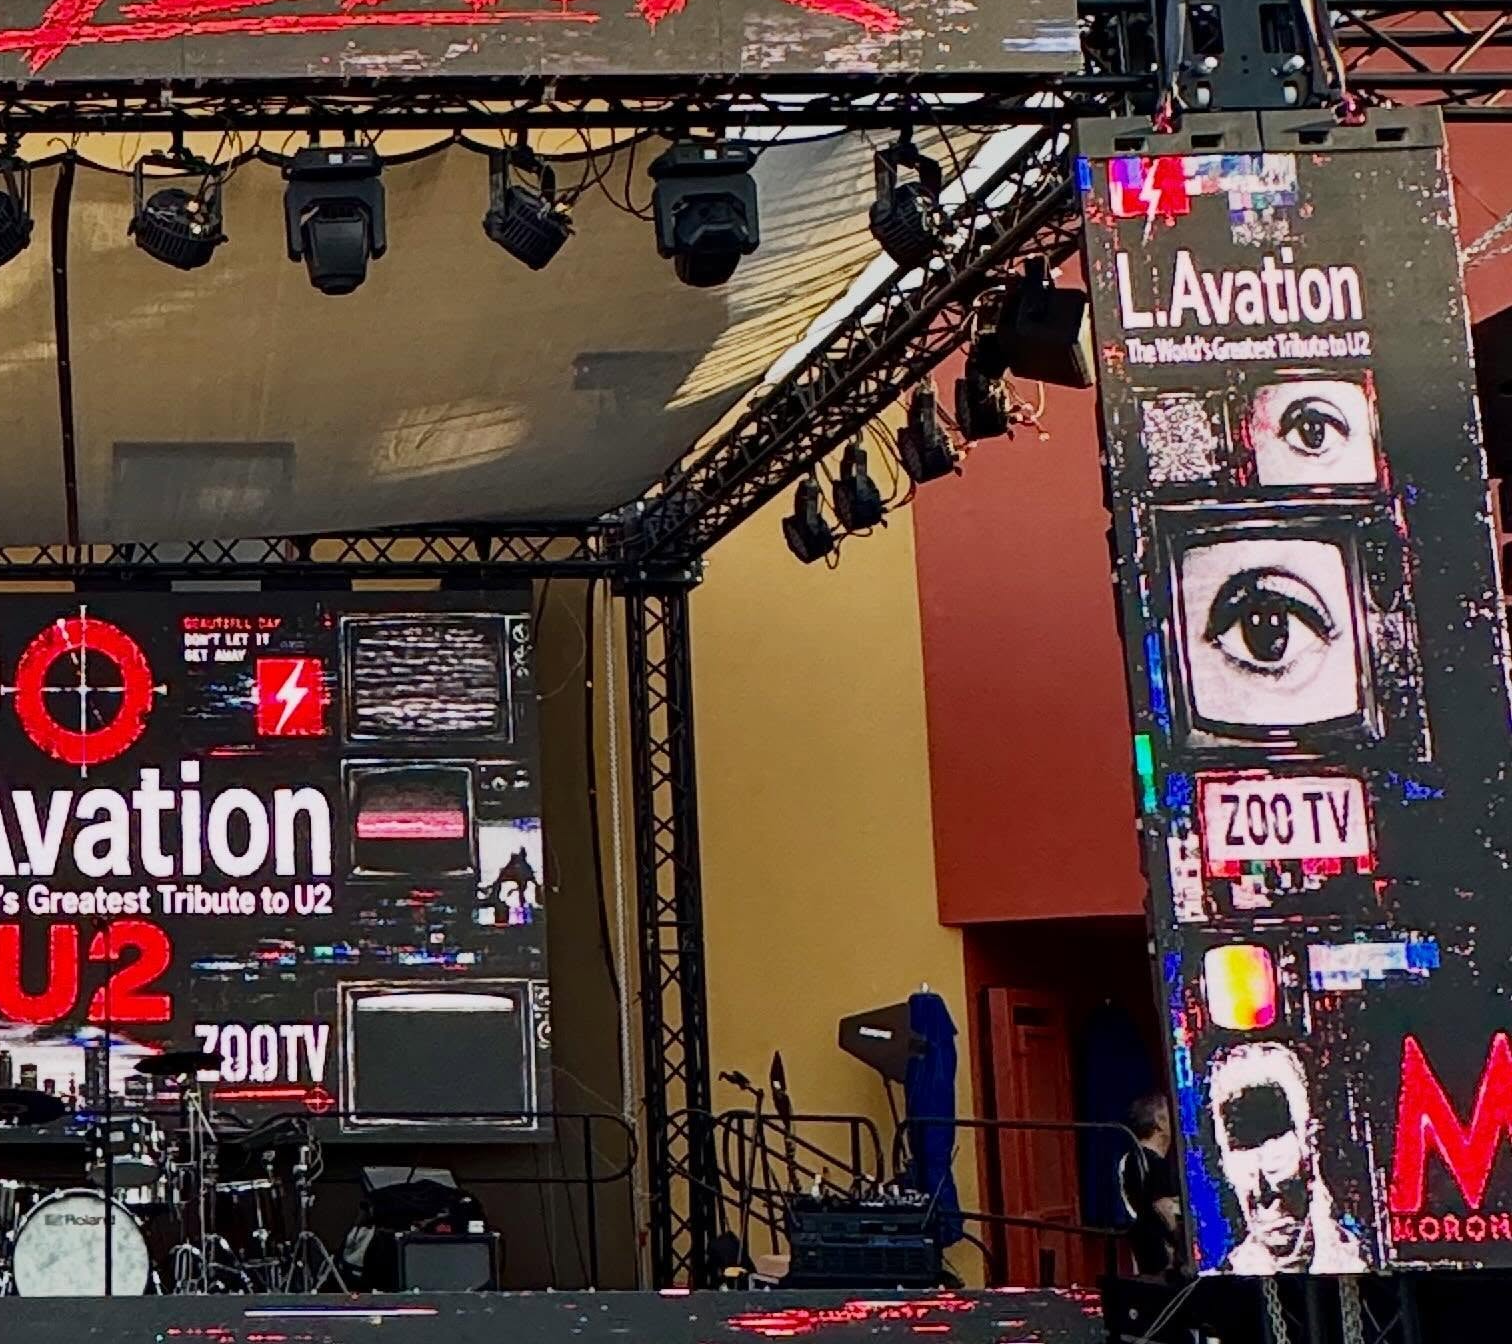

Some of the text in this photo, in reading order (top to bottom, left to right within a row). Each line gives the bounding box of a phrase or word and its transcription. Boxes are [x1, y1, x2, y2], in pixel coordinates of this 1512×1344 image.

[1116, 246, 1364, 329] L.Avation
[1125, 331, 1372, 363] The World's Greatest Tribute to U2
[225, 632, 250, 646] LET
[1221, 790, 1350, 846] ZOO TV
[27, 883, 152, 915] Greatest
[157, 884, 256, 915] Tribute
[261, 885, 289, 915] to
[294, 883, 334, 915] U2
